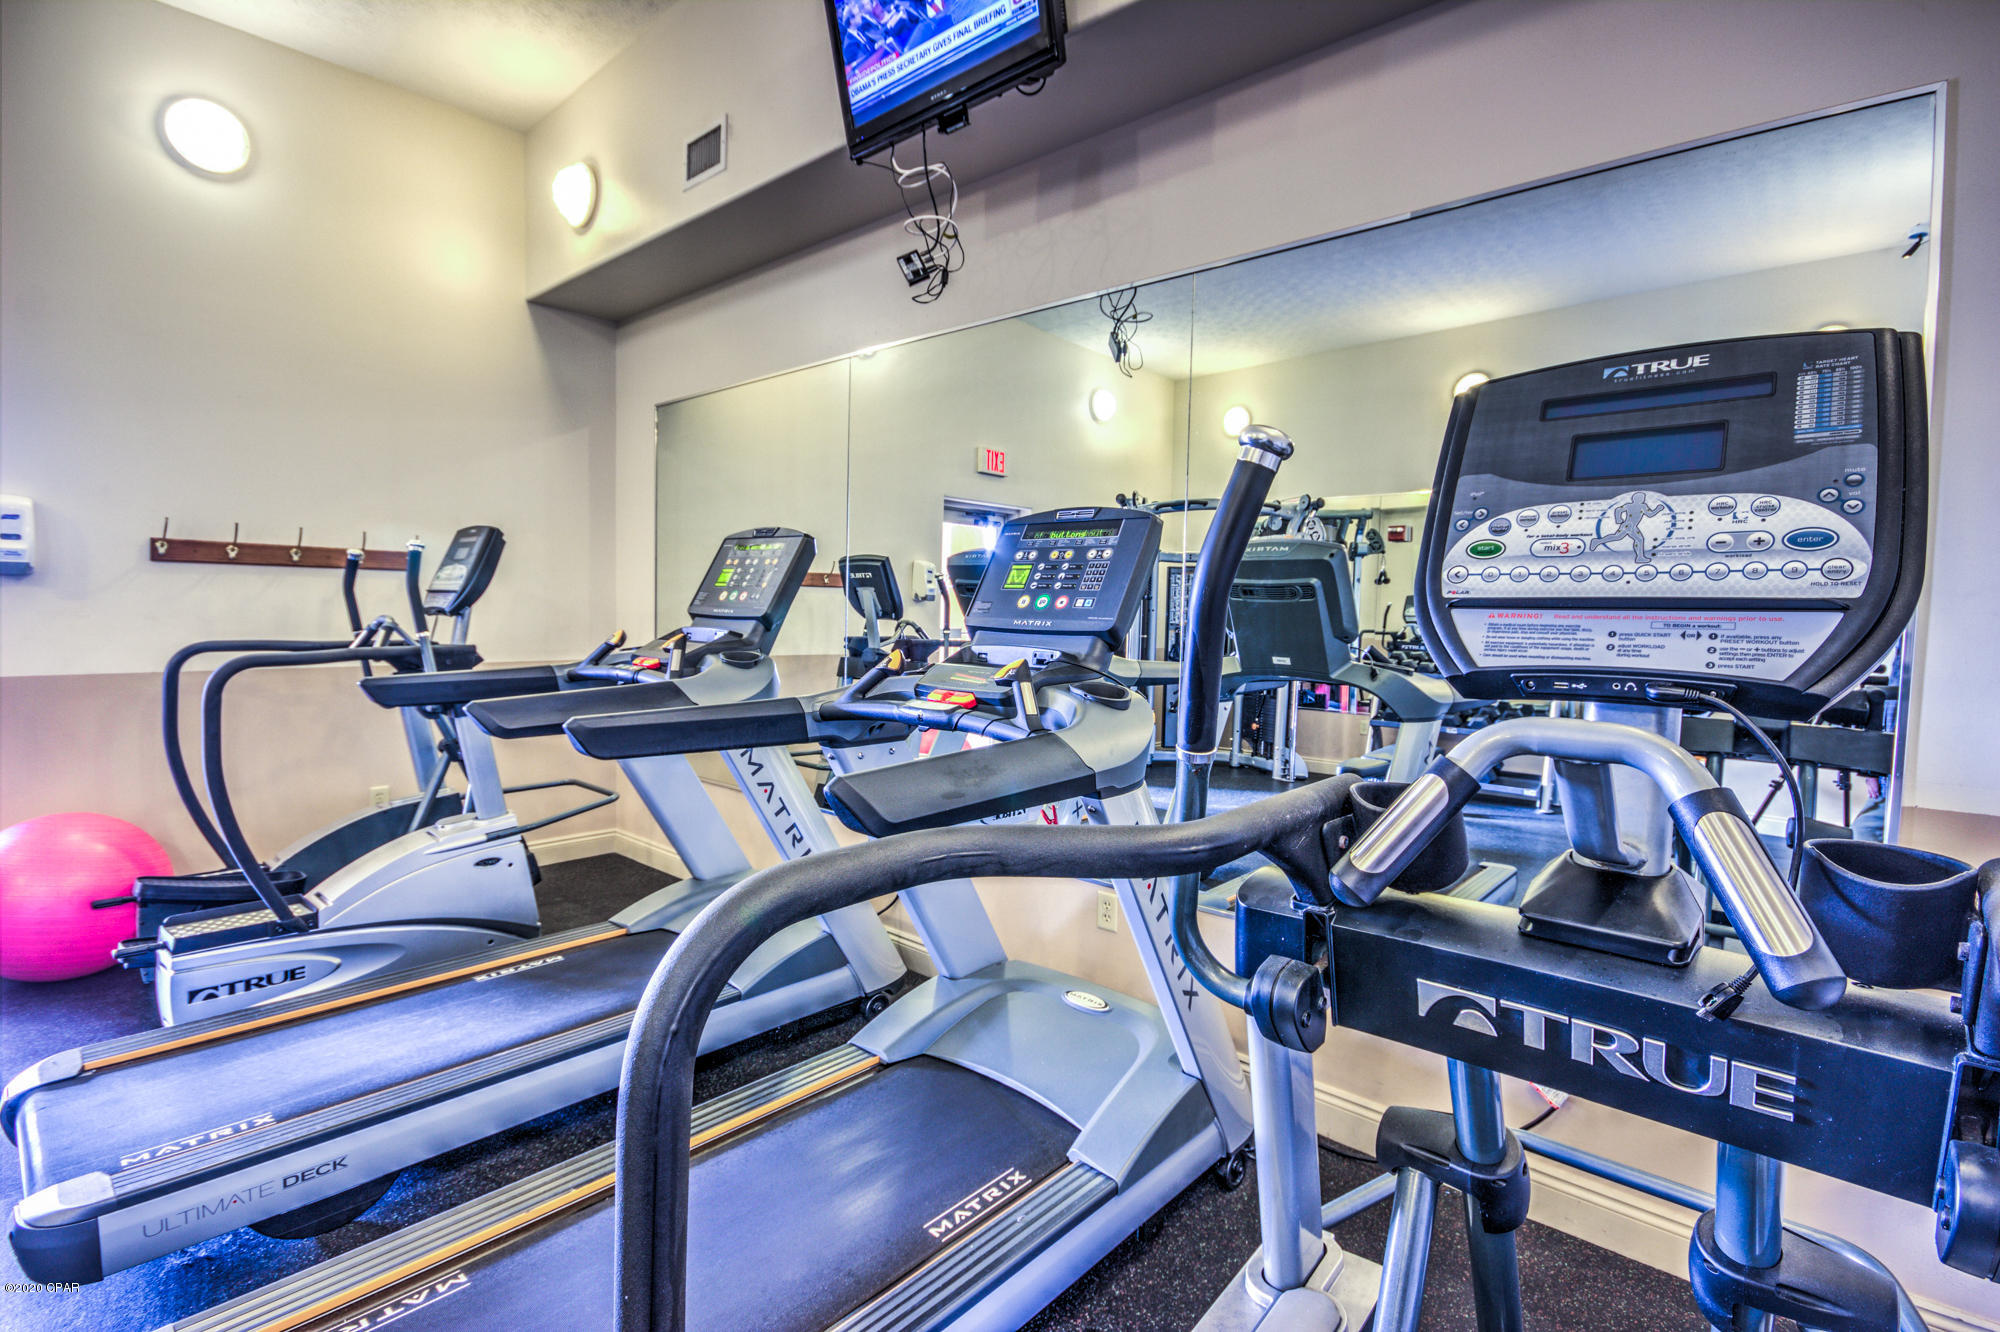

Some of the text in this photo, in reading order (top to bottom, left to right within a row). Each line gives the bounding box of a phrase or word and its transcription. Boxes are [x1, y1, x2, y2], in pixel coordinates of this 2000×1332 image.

[851, 79, 877, 97] OBAMA'S
[877, 68, 896, 86] PRESS
[896, 48, 931, 72] SECRETARY
[932, 38, 952, 54] GIVES
[953, 27, 973, 41] FINAL
[973, 4, 1007, 32] BRIEFING
[1631, 354, 1711, 375] TRUE
[1013, 619, 1053, 628] MATRIX
[220, 966, 306, 995] TRUE
[1500, 999, 1797, 1122] TRUE
[120, 1115, 276, 1168] MATRIX
[142, 1155, 349, 1238] ULTIMATE DECK
[928, 1170, 1027, 1238] MATRIX
